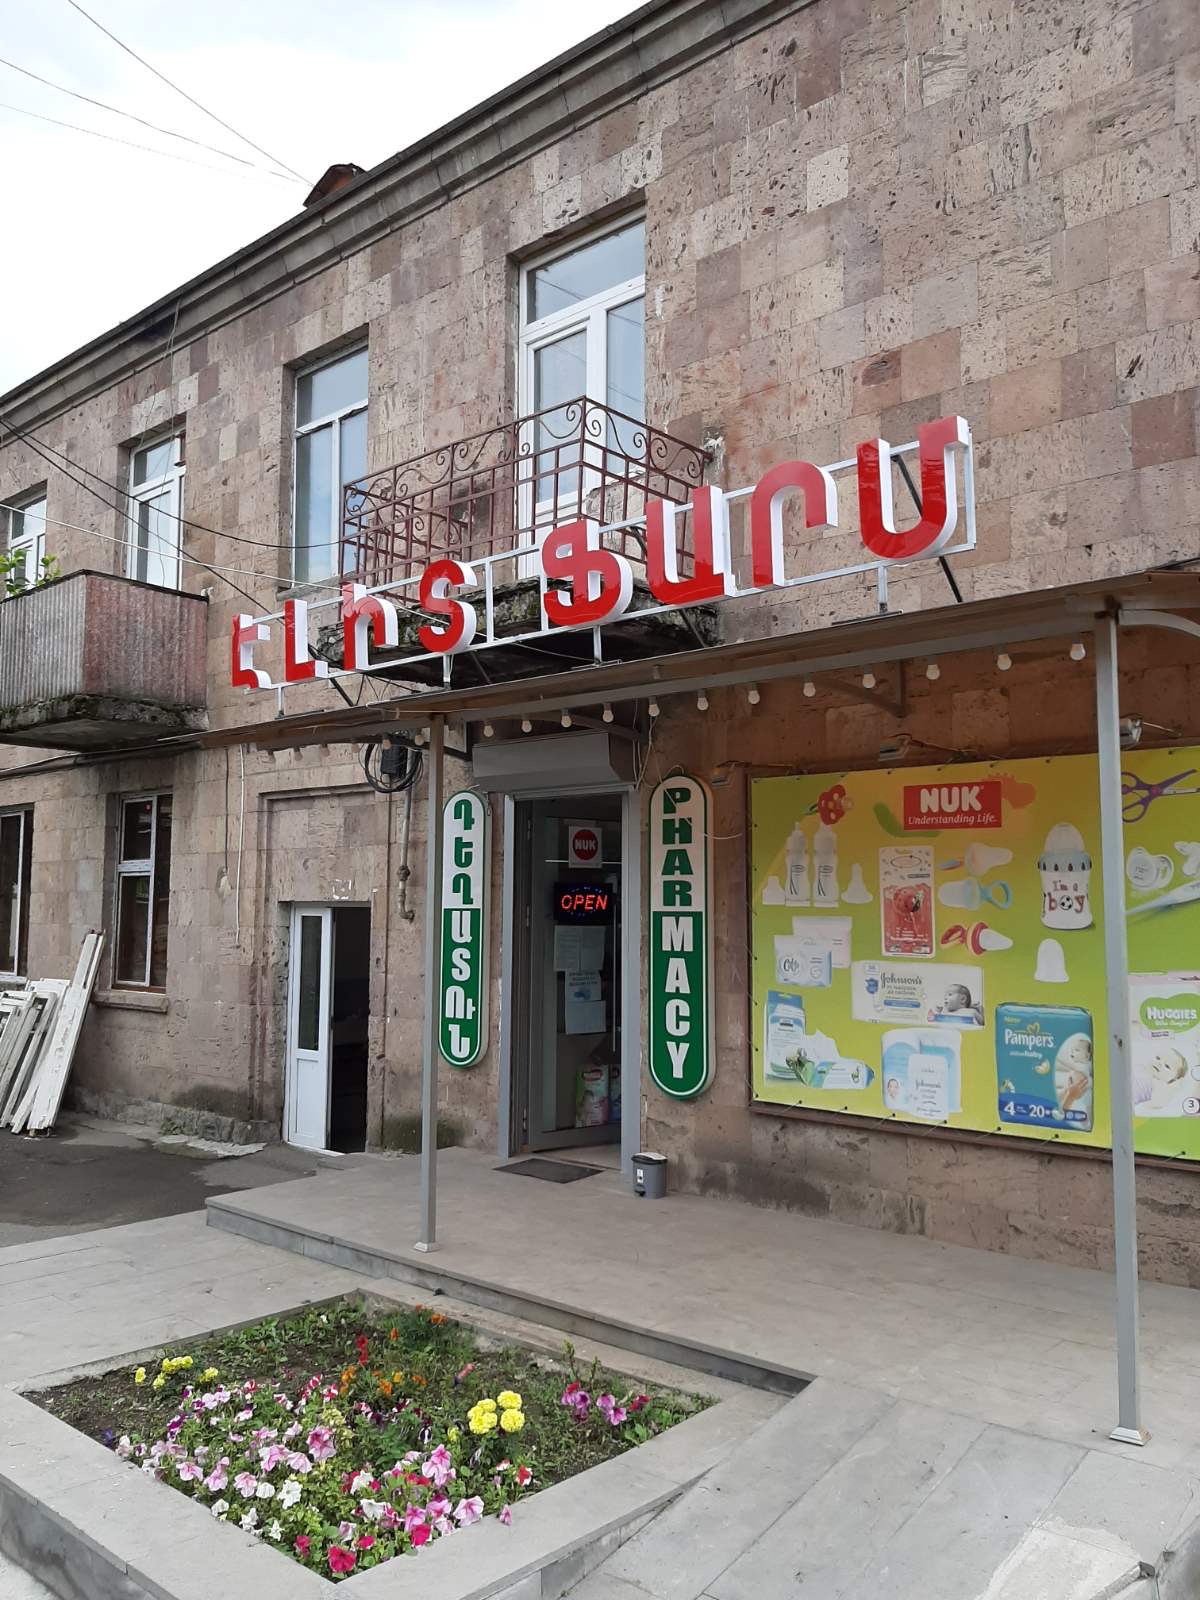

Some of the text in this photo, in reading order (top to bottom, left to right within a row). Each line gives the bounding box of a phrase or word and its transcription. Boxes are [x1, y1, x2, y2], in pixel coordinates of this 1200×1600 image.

[542, 415, 968, 628] ՖԱՐՄ
[920, 786, 982, 813] NUK
[908, 813, 975, 826] Understanding
[575, 840, 596, 850] NUK
[561, 894, 608, 910] OPEN
[662, 787, 694, 1079] PHARMACY
[1004, 1028, 1054, 1050] Pampers
[1003, 1101, 1016, 1116] 4
[1028, 1104, 1045, 1118] 20
[1188, 1099, 1195, 1109] 3
